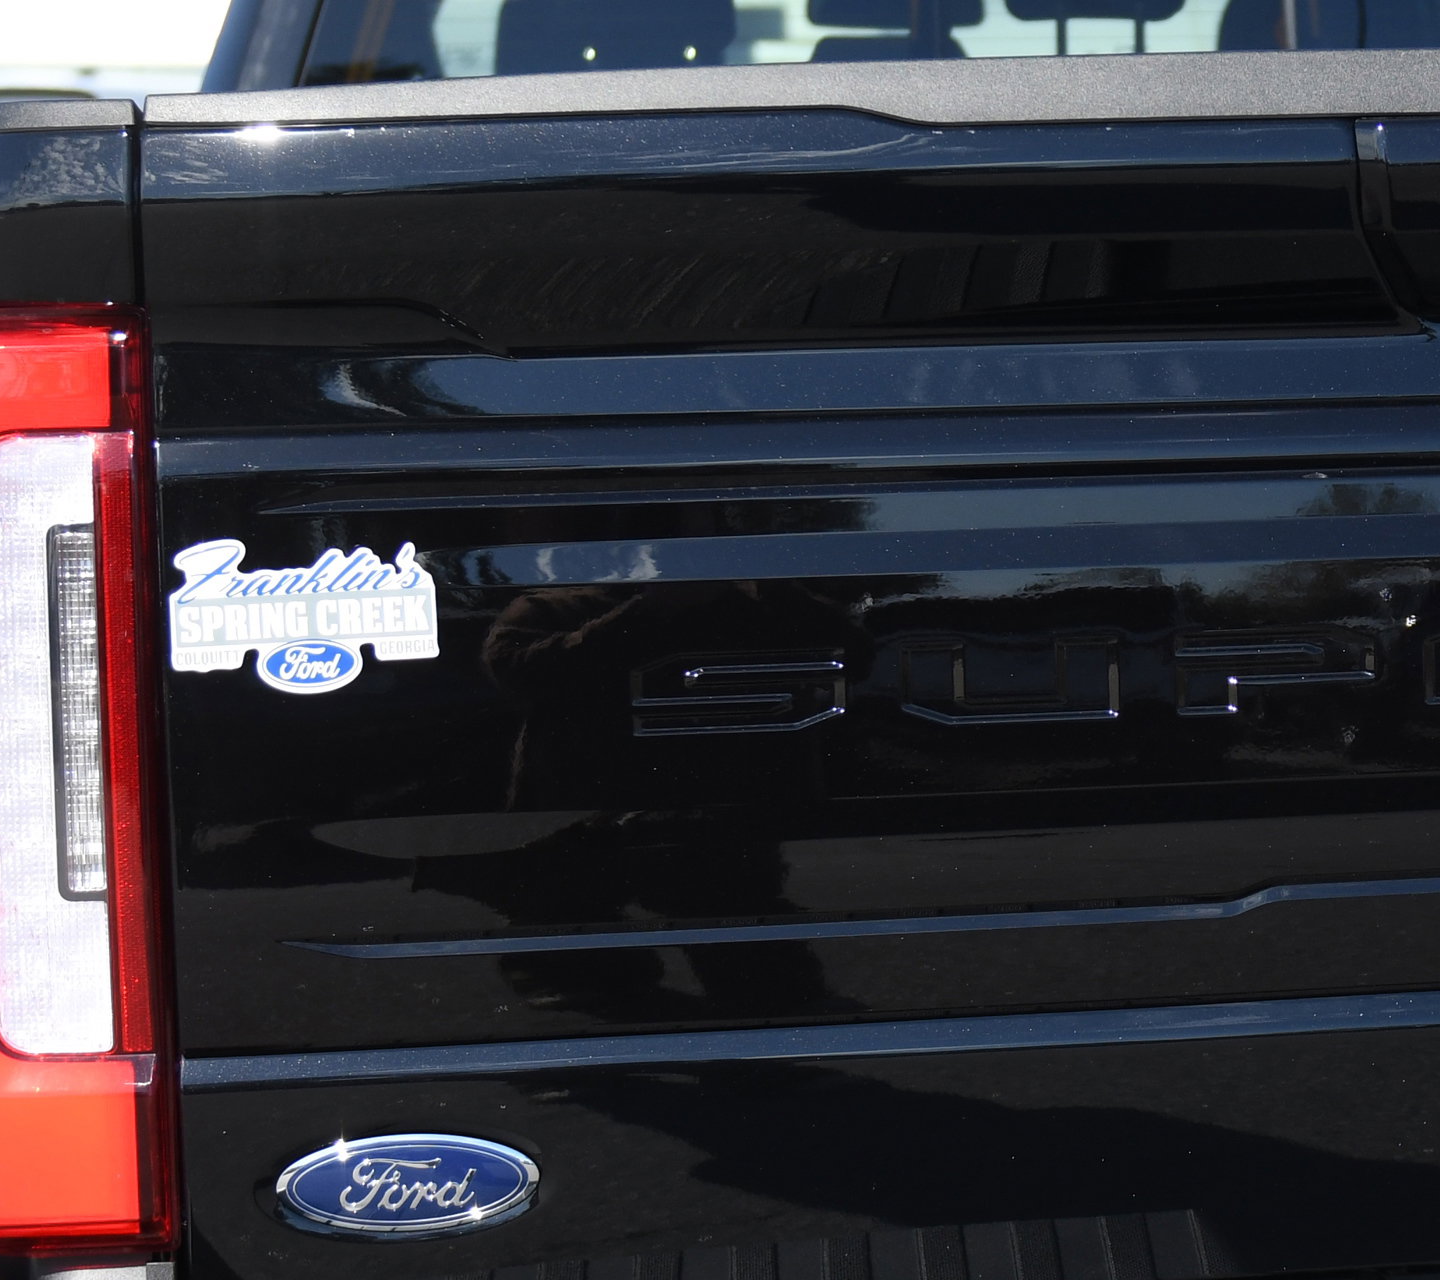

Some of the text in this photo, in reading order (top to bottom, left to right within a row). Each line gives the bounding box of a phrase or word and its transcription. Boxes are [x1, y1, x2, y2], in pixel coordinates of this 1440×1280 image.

[177, 545, 427, 604] Franklin's
[177, 595, 429, 643] SPRING CREEK
[176, 650, 241, 666] COLQUITT
[279, 646, 341, 680] Ford
[380, 639, 435, 654] GEORGIA
[339, 1157, 477, 1212] Ford
